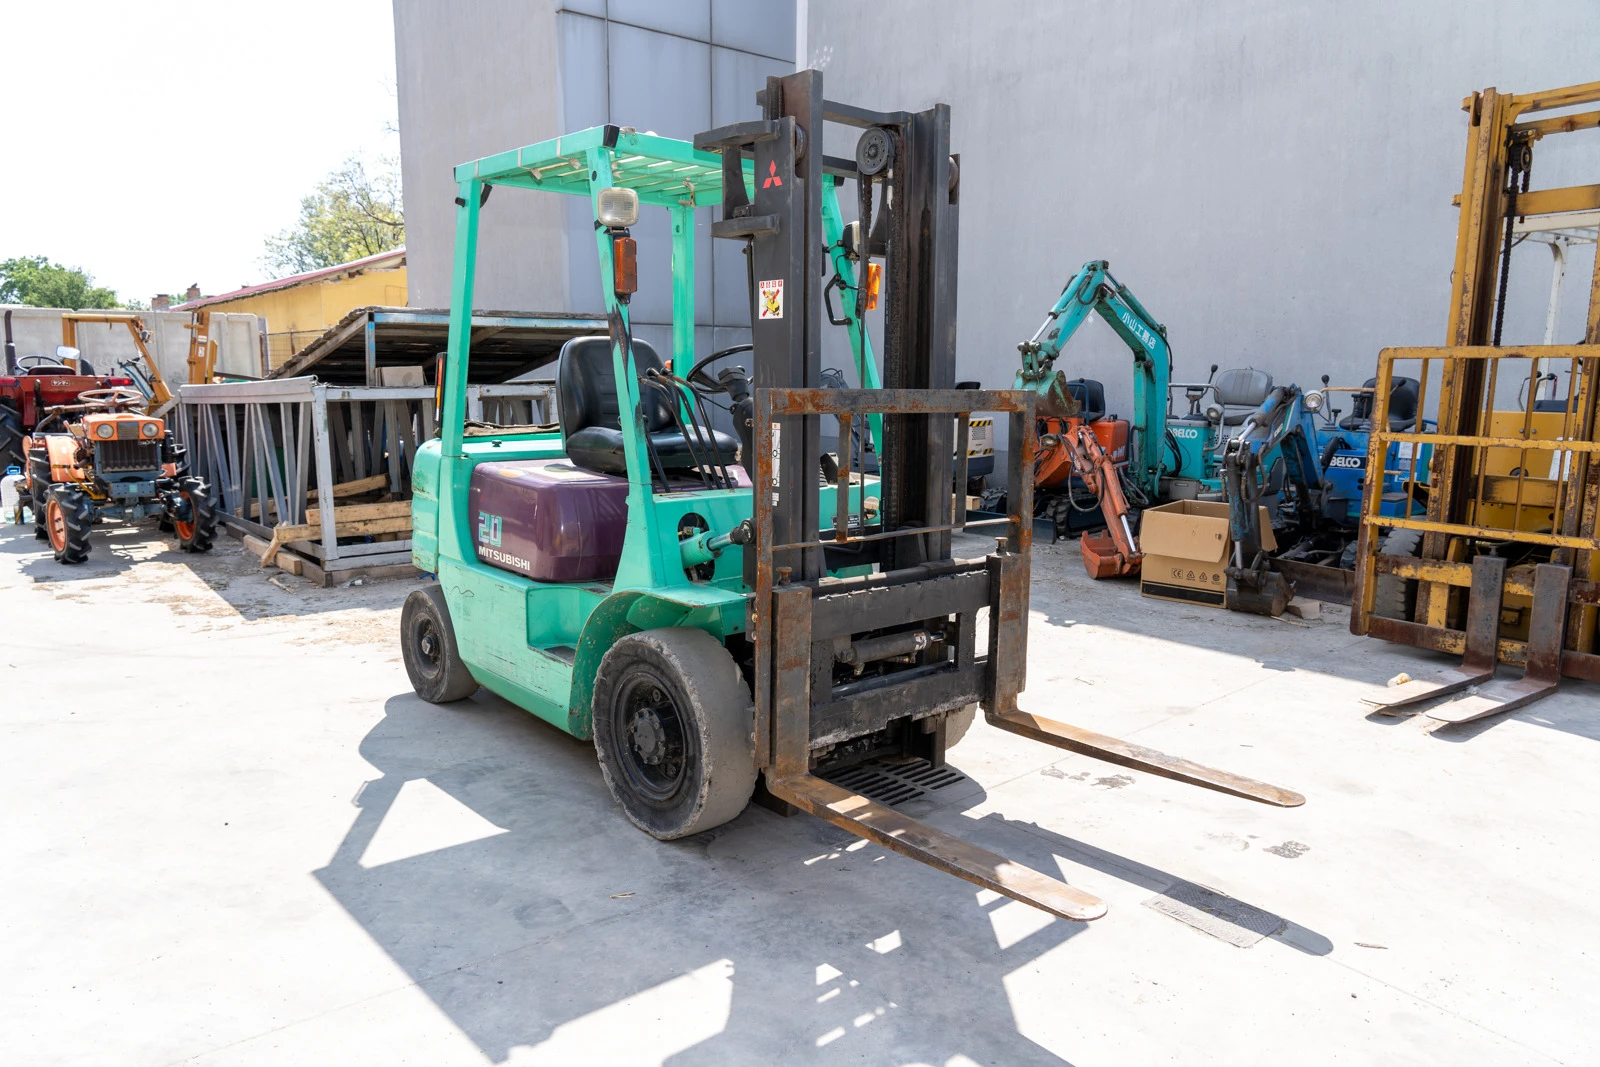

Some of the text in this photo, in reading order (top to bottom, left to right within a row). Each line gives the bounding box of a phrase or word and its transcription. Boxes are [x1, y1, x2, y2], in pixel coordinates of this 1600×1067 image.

[1172, 428, 1198, 439] BELCO
[1320, 456, 1361, 468] BELCO
[478, 511, 503, 548] 20
[478, 545, 531, 571] MITSUBISHI
